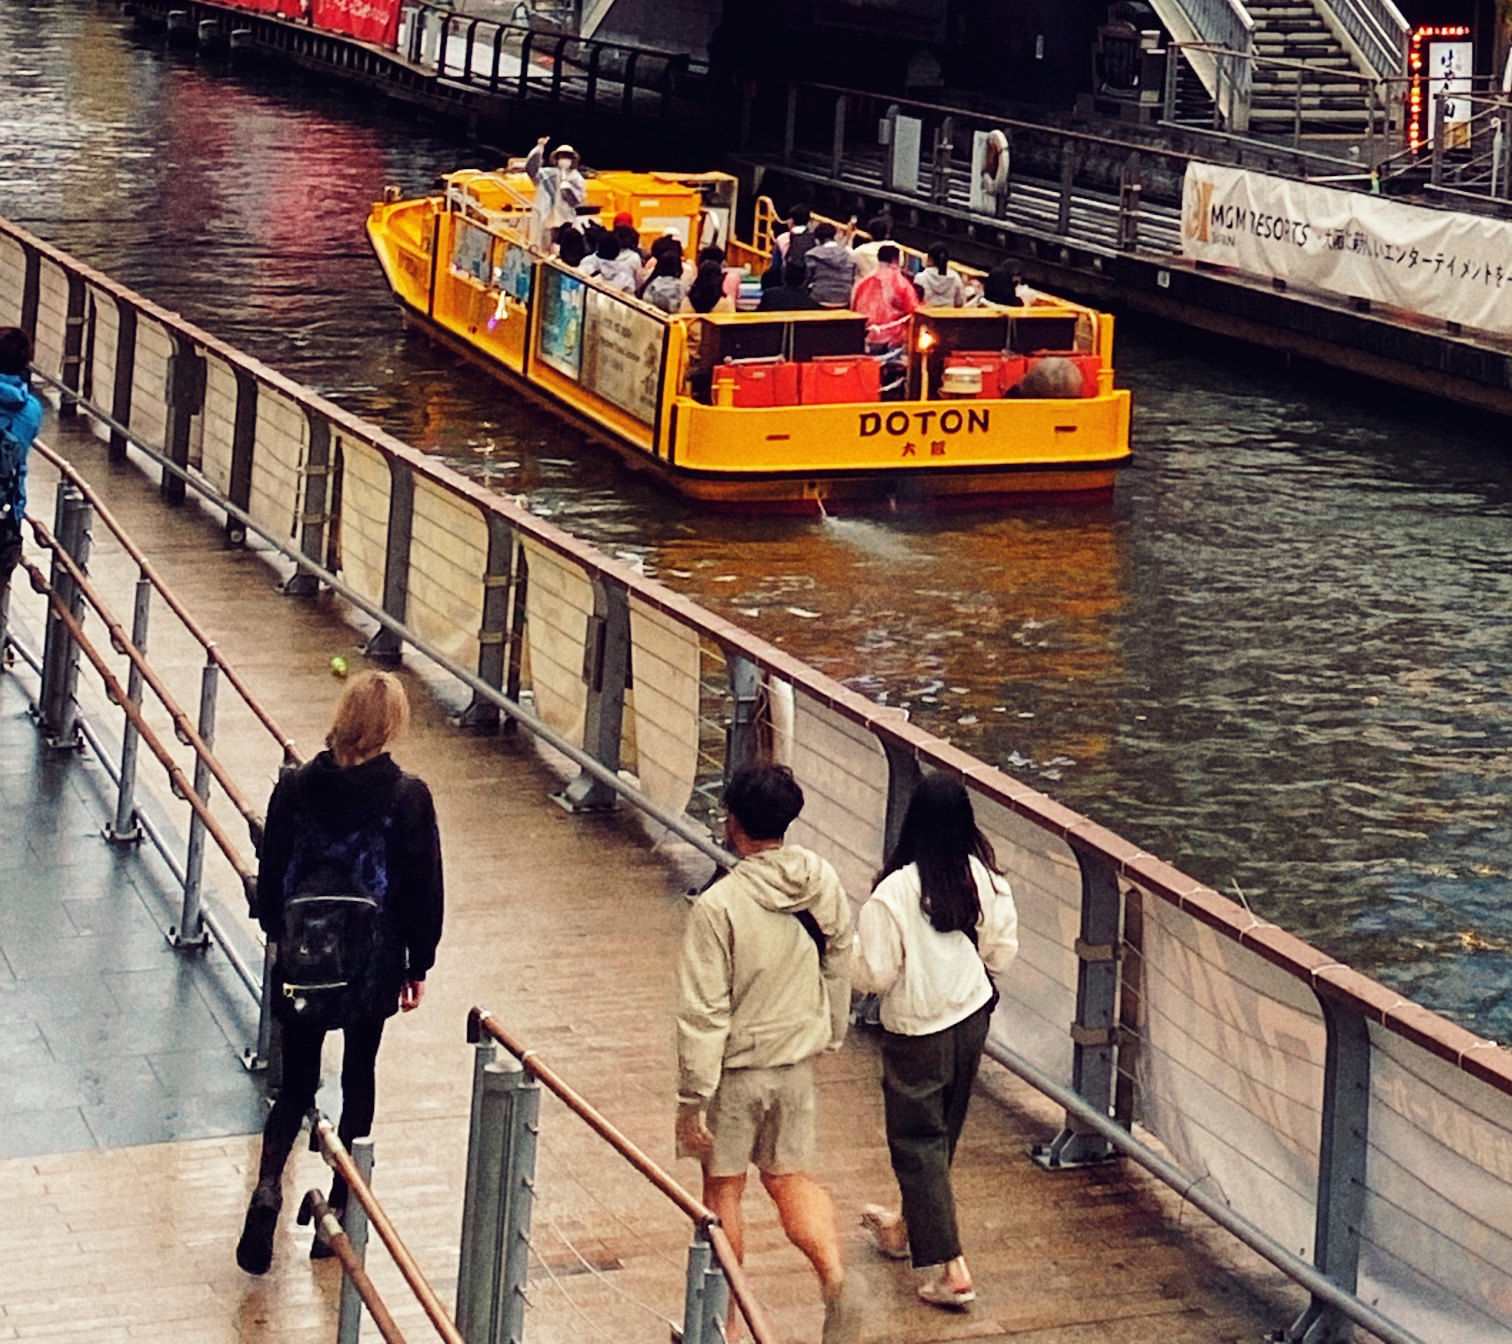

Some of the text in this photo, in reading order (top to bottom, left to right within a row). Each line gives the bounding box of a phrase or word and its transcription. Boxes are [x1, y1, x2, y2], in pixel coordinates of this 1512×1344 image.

[1210, 203, 1247, 233] MGM
[858, 408, 992, 439] DOTON
[901, 439, 947, 458] 大阪
